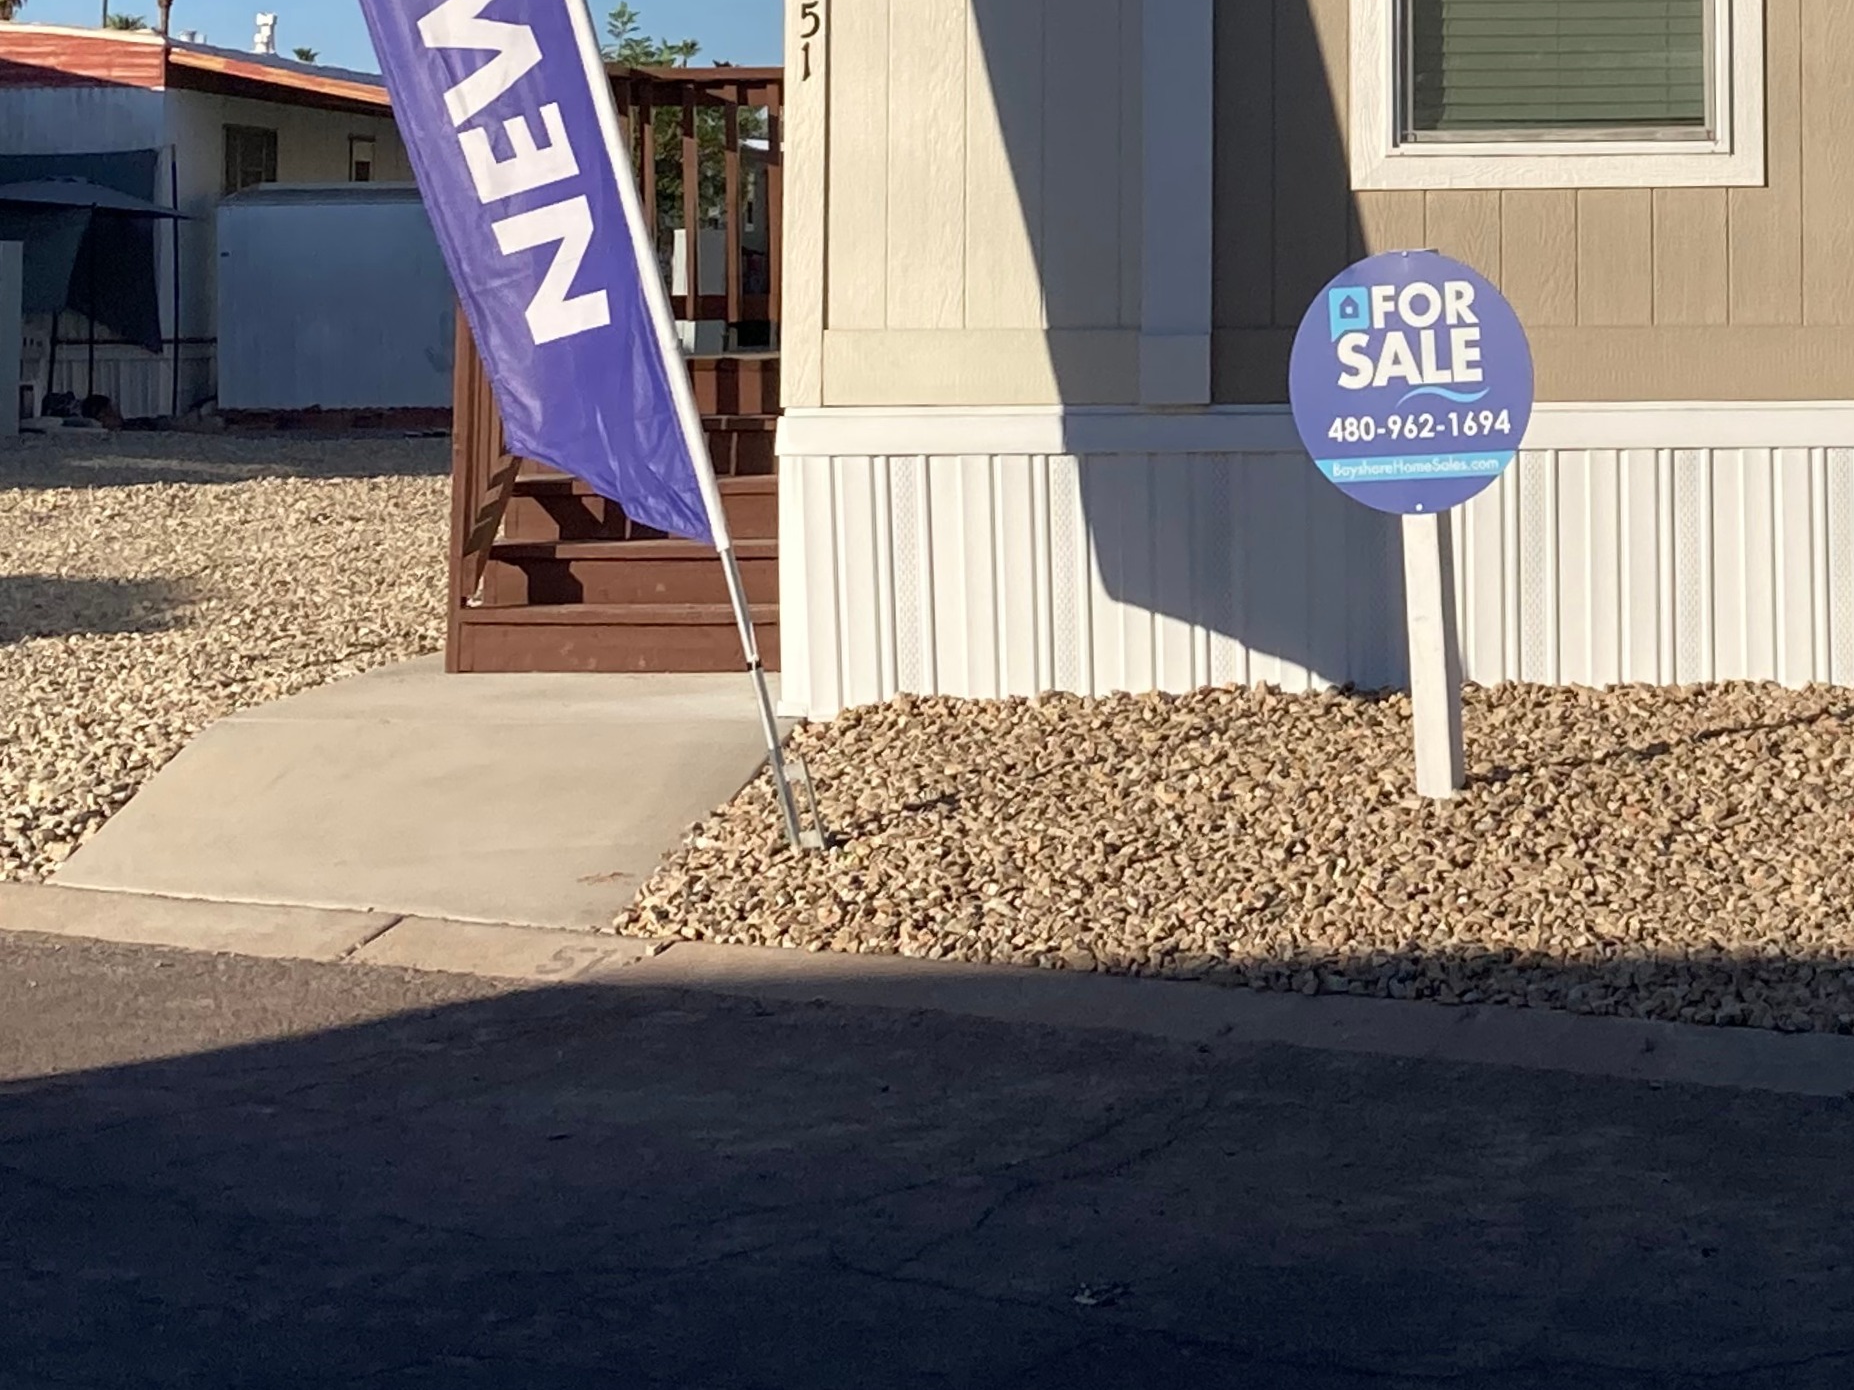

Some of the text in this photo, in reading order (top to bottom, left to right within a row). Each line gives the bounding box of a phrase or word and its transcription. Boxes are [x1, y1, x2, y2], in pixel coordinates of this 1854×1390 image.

[800, 0, 820, 82] 51
[1370, 281, 1480, 329] FOR
[1336, 327, 1484, 390] SALE
[1328, 409, 1511, 442] 480-962-1694
[1332, 457, 1499, 479] BayshoreHomeSales.com
